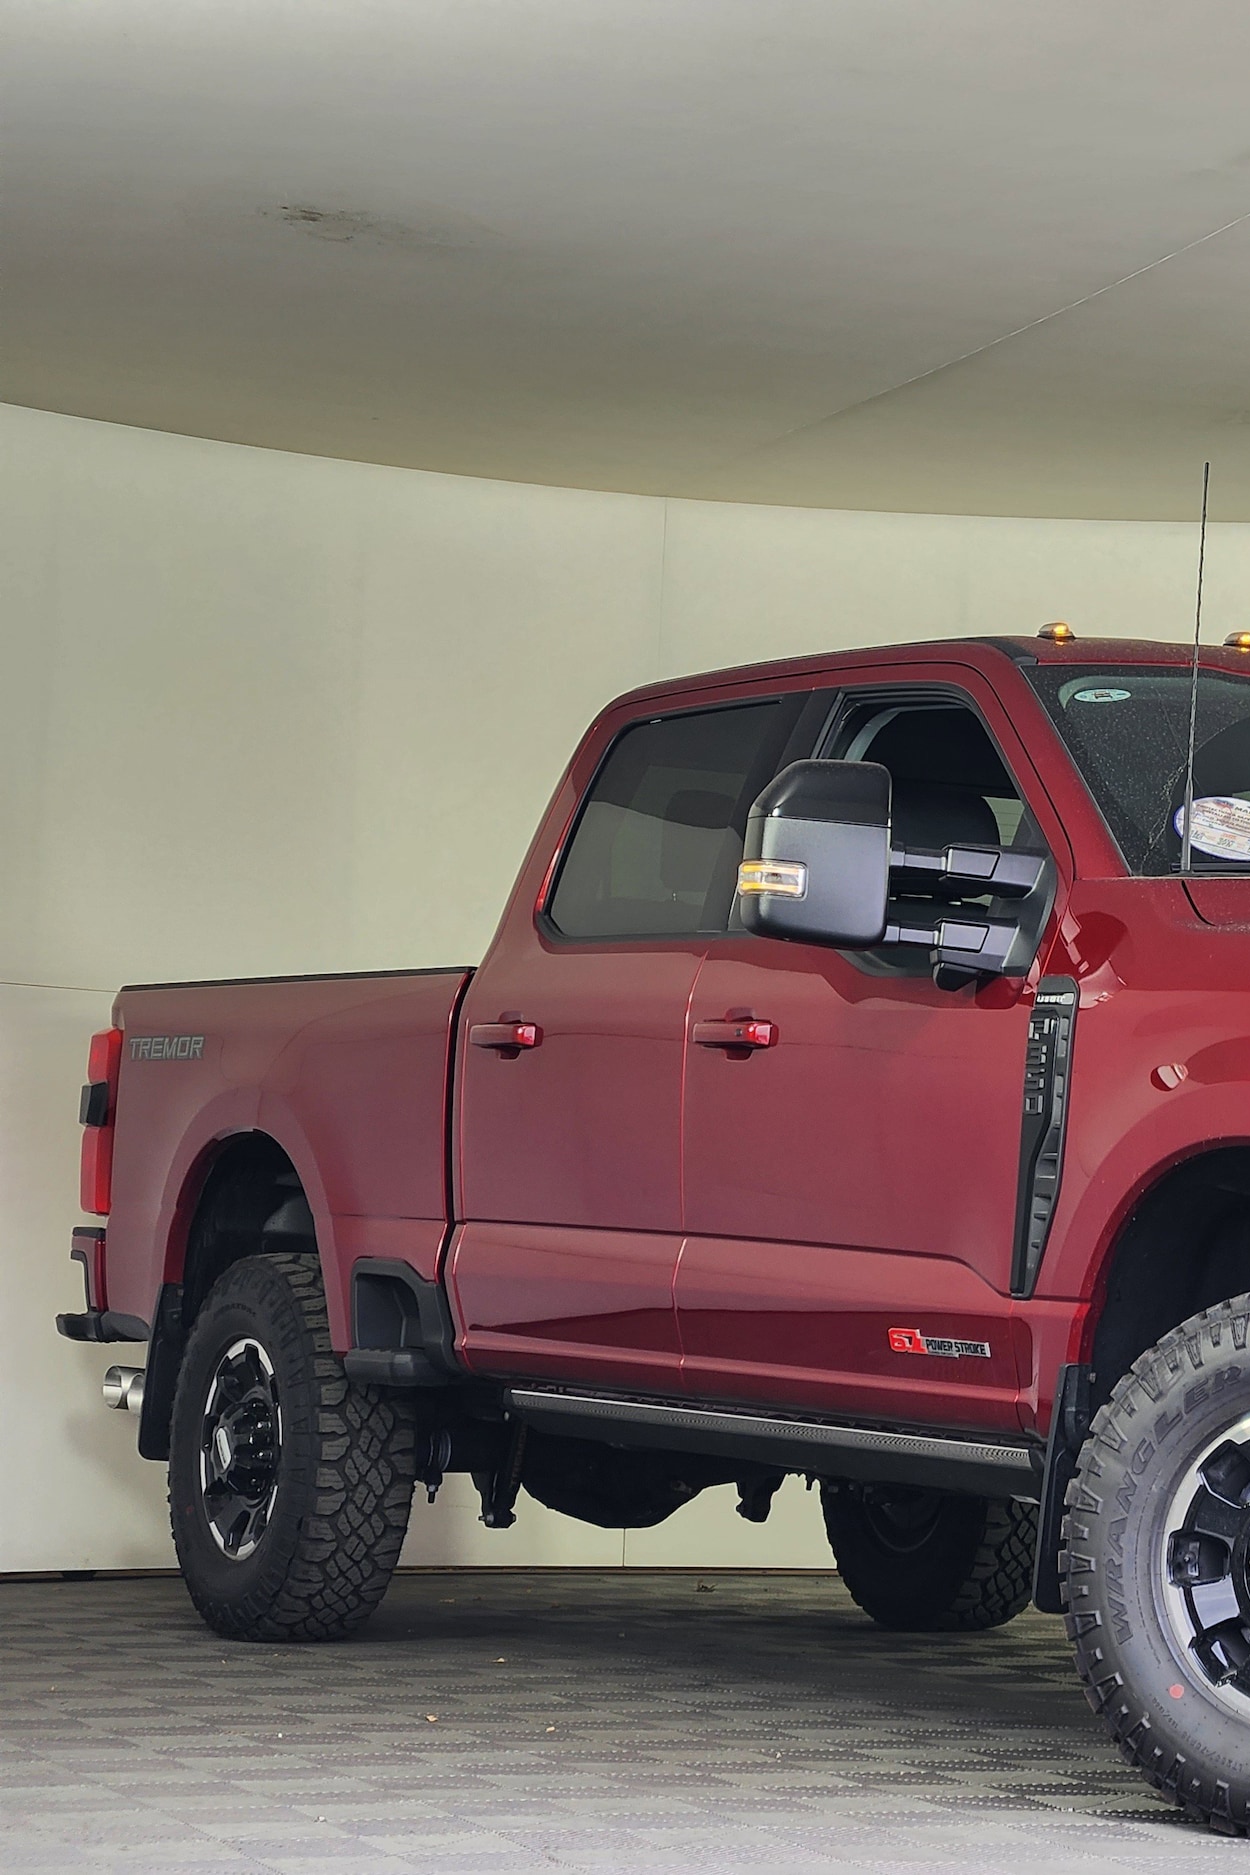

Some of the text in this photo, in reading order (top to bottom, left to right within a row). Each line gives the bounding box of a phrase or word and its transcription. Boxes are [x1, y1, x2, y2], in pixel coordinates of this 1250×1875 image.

[128, 1035, 205, 1060] TREMOR
[925, 1338, 954, 1353] POWER
[954, 1340, 986, 1355] STROKE
[1107, 1365, 1243, 1646] WRANGLER
